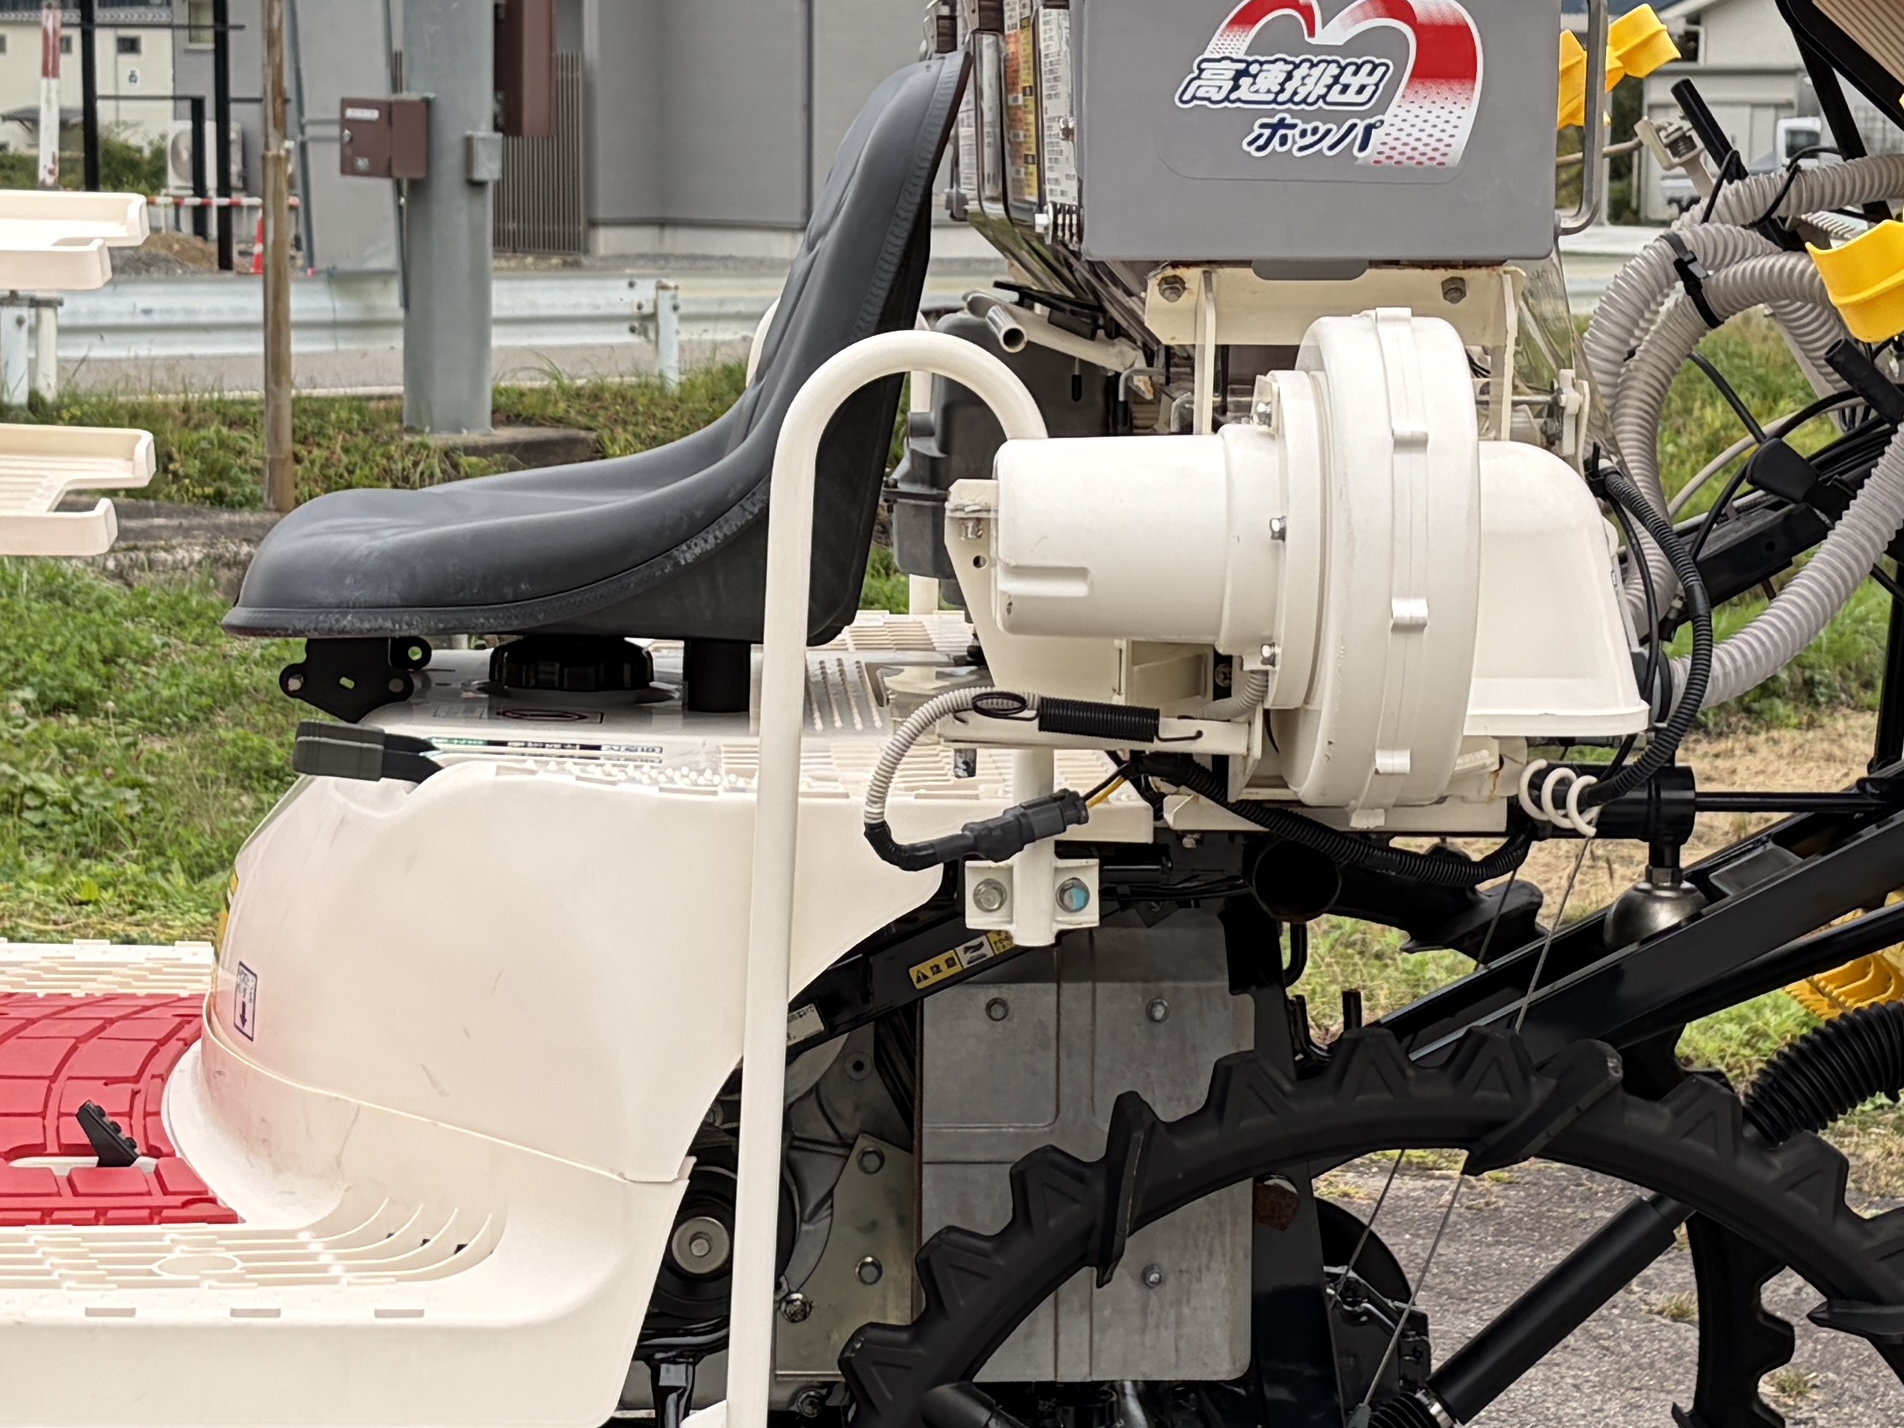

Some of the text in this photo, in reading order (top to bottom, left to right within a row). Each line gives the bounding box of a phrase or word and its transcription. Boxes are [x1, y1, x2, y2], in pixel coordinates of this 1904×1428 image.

[1178, 56, 1391, 107] 高速排出
[1244, 115, 1386, 154] ホッパ
